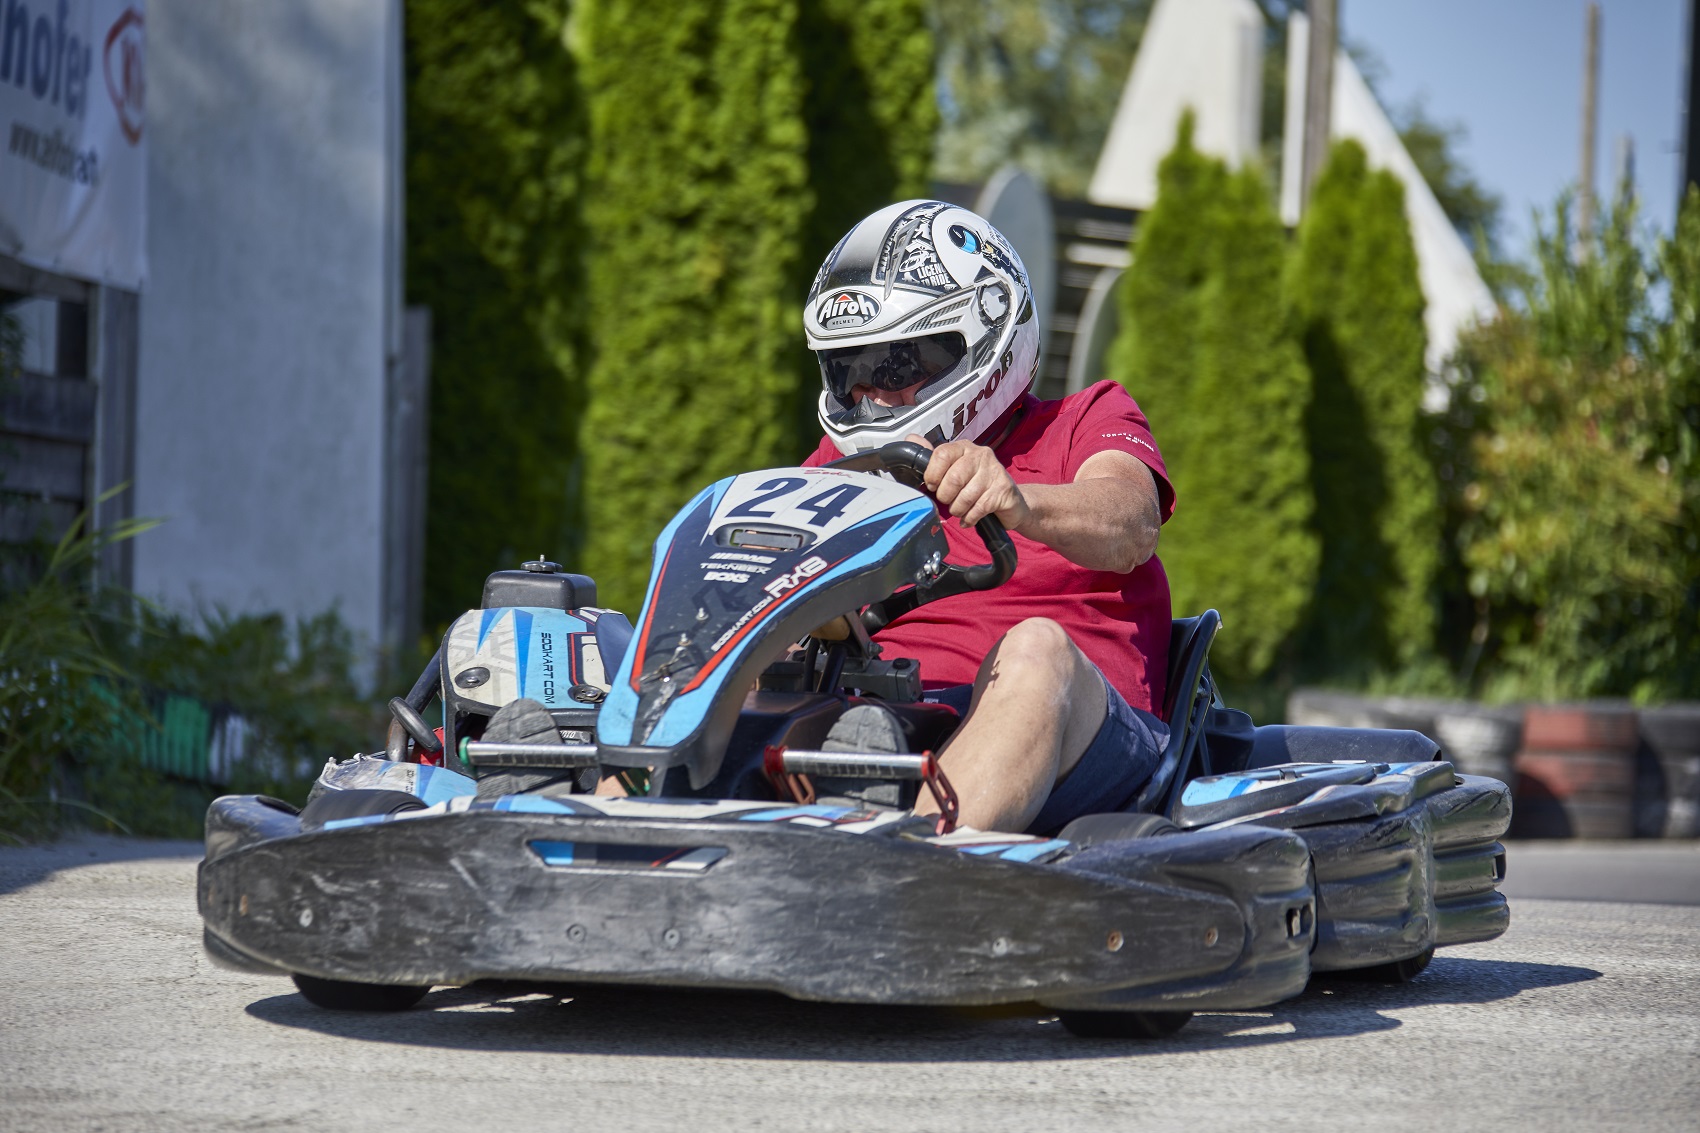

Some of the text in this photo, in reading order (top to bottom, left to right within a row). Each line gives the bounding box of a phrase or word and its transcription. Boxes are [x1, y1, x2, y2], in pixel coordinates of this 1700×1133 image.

[929, 272, 951, 287] RIDE
[819, 294, 876, 323] Airoh
[724, 477, 868, 528] 24
